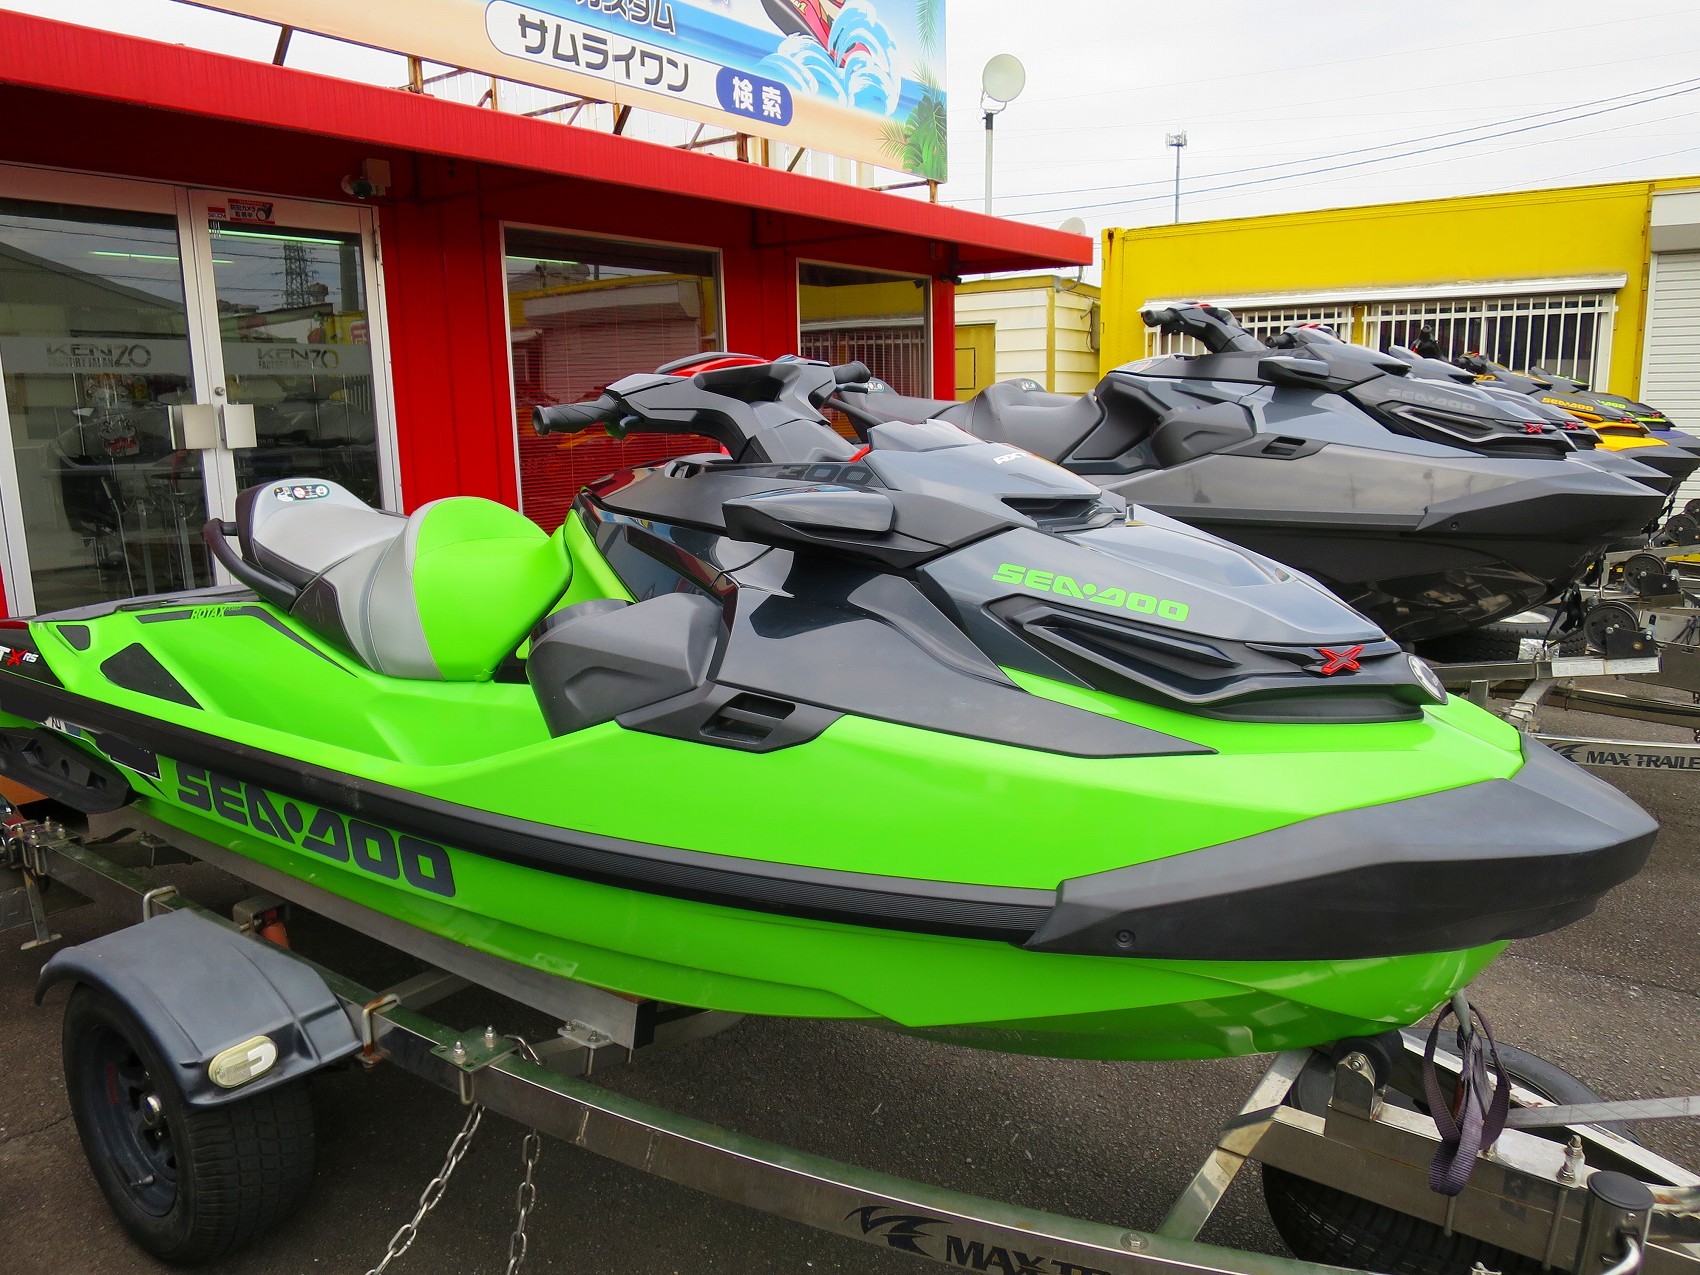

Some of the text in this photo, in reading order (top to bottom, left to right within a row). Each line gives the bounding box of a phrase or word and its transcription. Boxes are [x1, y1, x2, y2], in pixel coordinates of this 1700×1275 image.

[518, 13, 782, 119] サムライワン 検索
[46, 343, 152, 368] KENZO
[257, 347, 340, 369] KENZO
[190, 606, 226, 620] ROTAX
[1586, 750, 1631, 767] MAX
